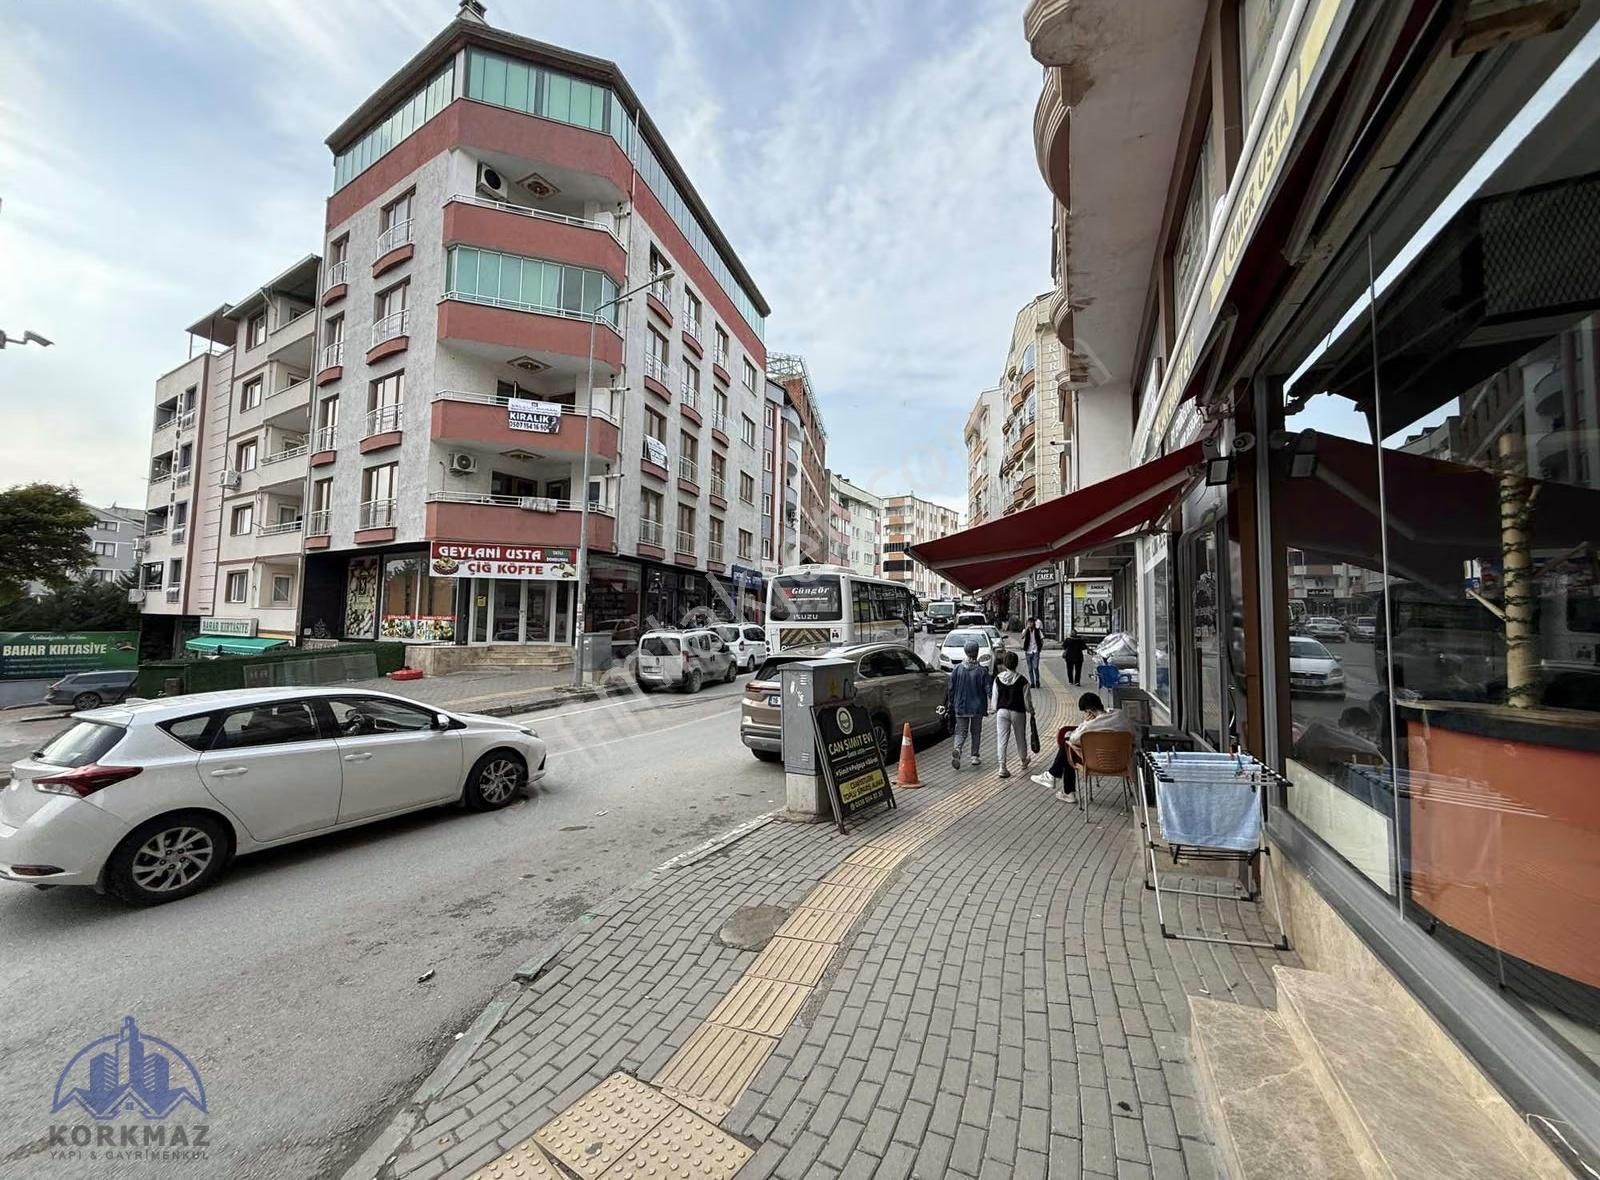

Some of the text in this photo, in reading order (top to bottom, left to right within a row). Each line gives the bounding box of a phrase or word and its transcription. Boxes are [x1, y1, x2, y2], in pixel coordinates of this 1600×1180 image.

[1258, 98, 1290, 191] USTA
[438, 546, 542, 561] GEYLANİ USTA
[467, 561, 544, 575] ÇİĞ KÖFTE
[791, 586, 830, 596] Güngör
[3, 642, 107, 657] BAHAR KIRTASİYE
[828, 740, 844, 755] CAN
